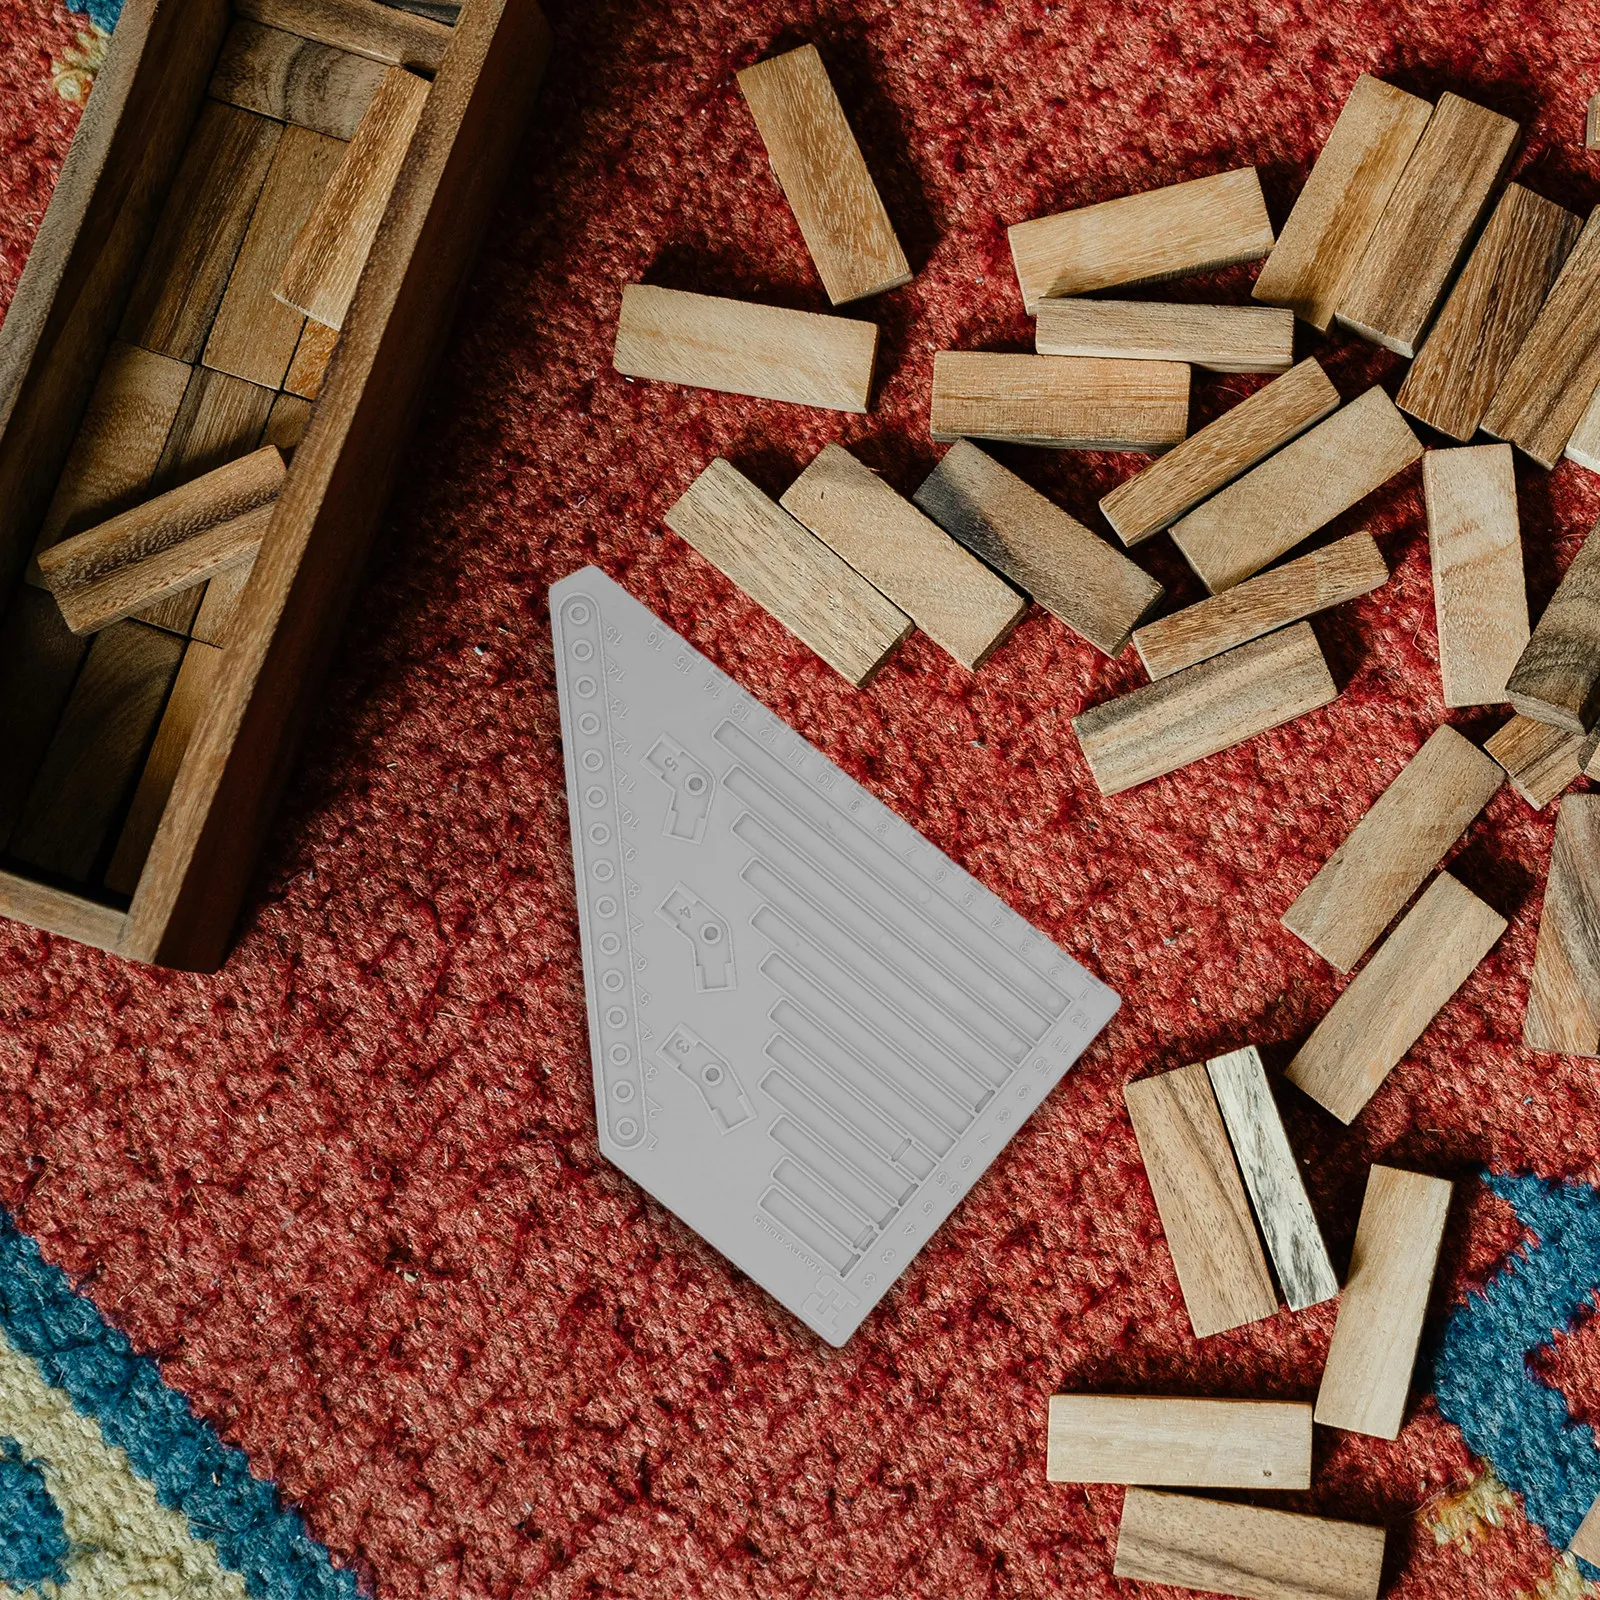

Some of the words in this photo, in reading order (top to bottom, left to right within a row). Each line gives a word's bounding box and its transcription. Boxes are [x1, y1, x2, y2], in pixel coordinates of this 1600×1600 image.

[607, 626, 623, 646] 15
[645, 631, 664, 652] 16
[607, 663, 626, 682] 14
[672, 656, 694, 675] 15
[703, 680, 722, 698] 14
[610, 700, 630, 719] 13
[731, 702, 751, 721] 13
[759, 728, 778, 744] 12
[613, 740, 633, 756] 12
[664, 756, 679, 771] 5
[787, 748, 806, 767] 11
[618, 774, 636, 793] 11
[816, 772, 838, 791] 10
[848, 799, 861, 813] 9
[621, 811, 640, 830] 10
[876, 822, 889, 836] 8
[625, 847, 638, 861] 9
[903, 846, 918, 859] 7
[934, 868, 947, 882] 6
[628, 884, 641, 898] 8
[963, 891, 977, 907] 5
[679, 905, 692, 919] 4
[631, 922, 644, 936] 7
[990, 916, 1003, 928] 4
[1020, 940, 1033, 954] 3
[635, 957, 648, 972] 6
[1048, 965, 1063, 978] 2
[639, 993, 652, 1008] 5
[1070, 1012, 1090, 1031] 12
[641, 1028, 655, 1041] 4
[675, 1040, 690, 1055] 3
[1051, 1036, 1071, 1055] 11
[645, 1067, 659, 1081] 3
[1033, 1057, 1054, 1077] 10
[1016, 1085, 1031, 1100] 9
[648, 1107, 663, 1119] 2
[996, 1109, 1011, 1123] 8
[977, 1133, 991, 1147] 7
[958, 1156, 972, 1170] 6
[920, 1201, 934, 1216] 5
[903, 1222, 916, 1235] 4
[785, 1243, 822, 1273] HAPPY
[882, 1249, 896, 1264] 3
[862, 1273, 877, 1288] 3
